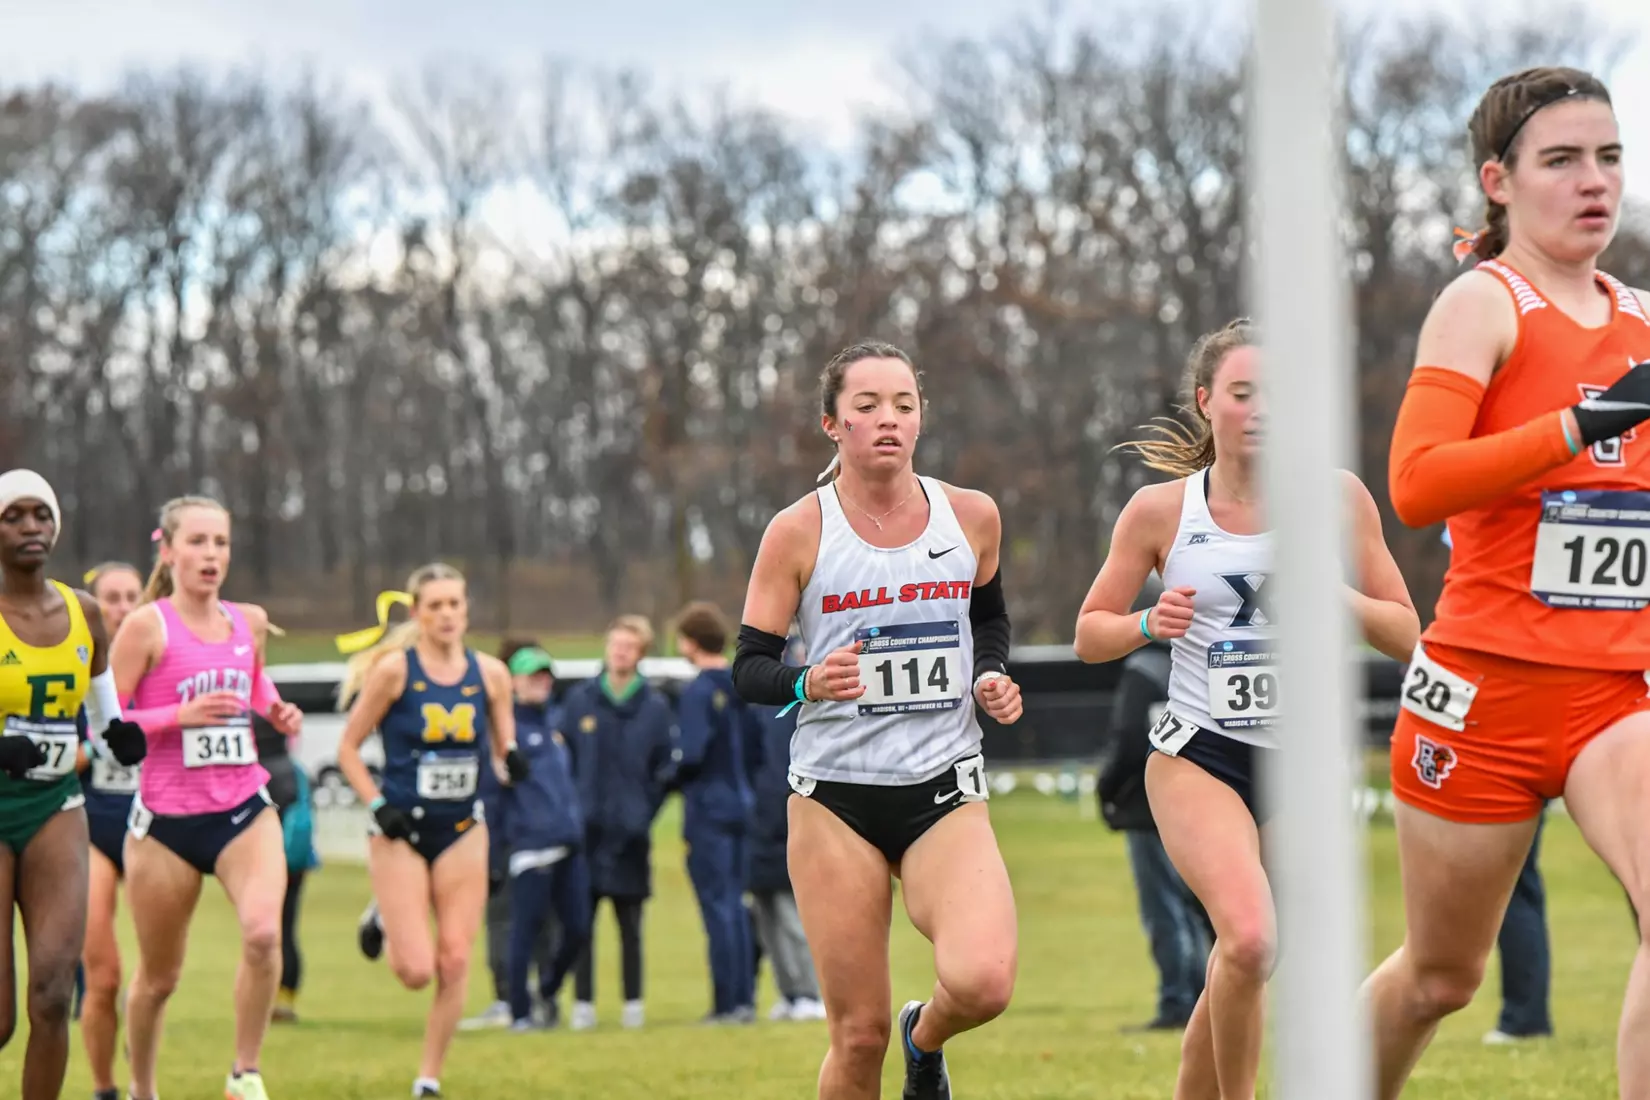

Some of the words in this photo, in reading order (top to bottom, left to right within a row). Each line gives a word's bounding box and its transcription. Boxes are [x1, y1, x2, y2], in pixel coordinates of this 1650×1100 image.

[1563, 535, 1647, 587] 120
[822, 587, 894, 614] BALL
[898, 580, 971, 603] STATE
[869, 639, 889, 647] CROSS
[890, 637, 917, 646] COUNTRY
[26, 672, 75, 722] E
[875, 656, 949, 697] 114
[1406, 665, 1451, 713] 20
[421, 702, 476, 743] M
[1153, 710, 1183, 743] 97
[197, 733, 244, 760] 341
